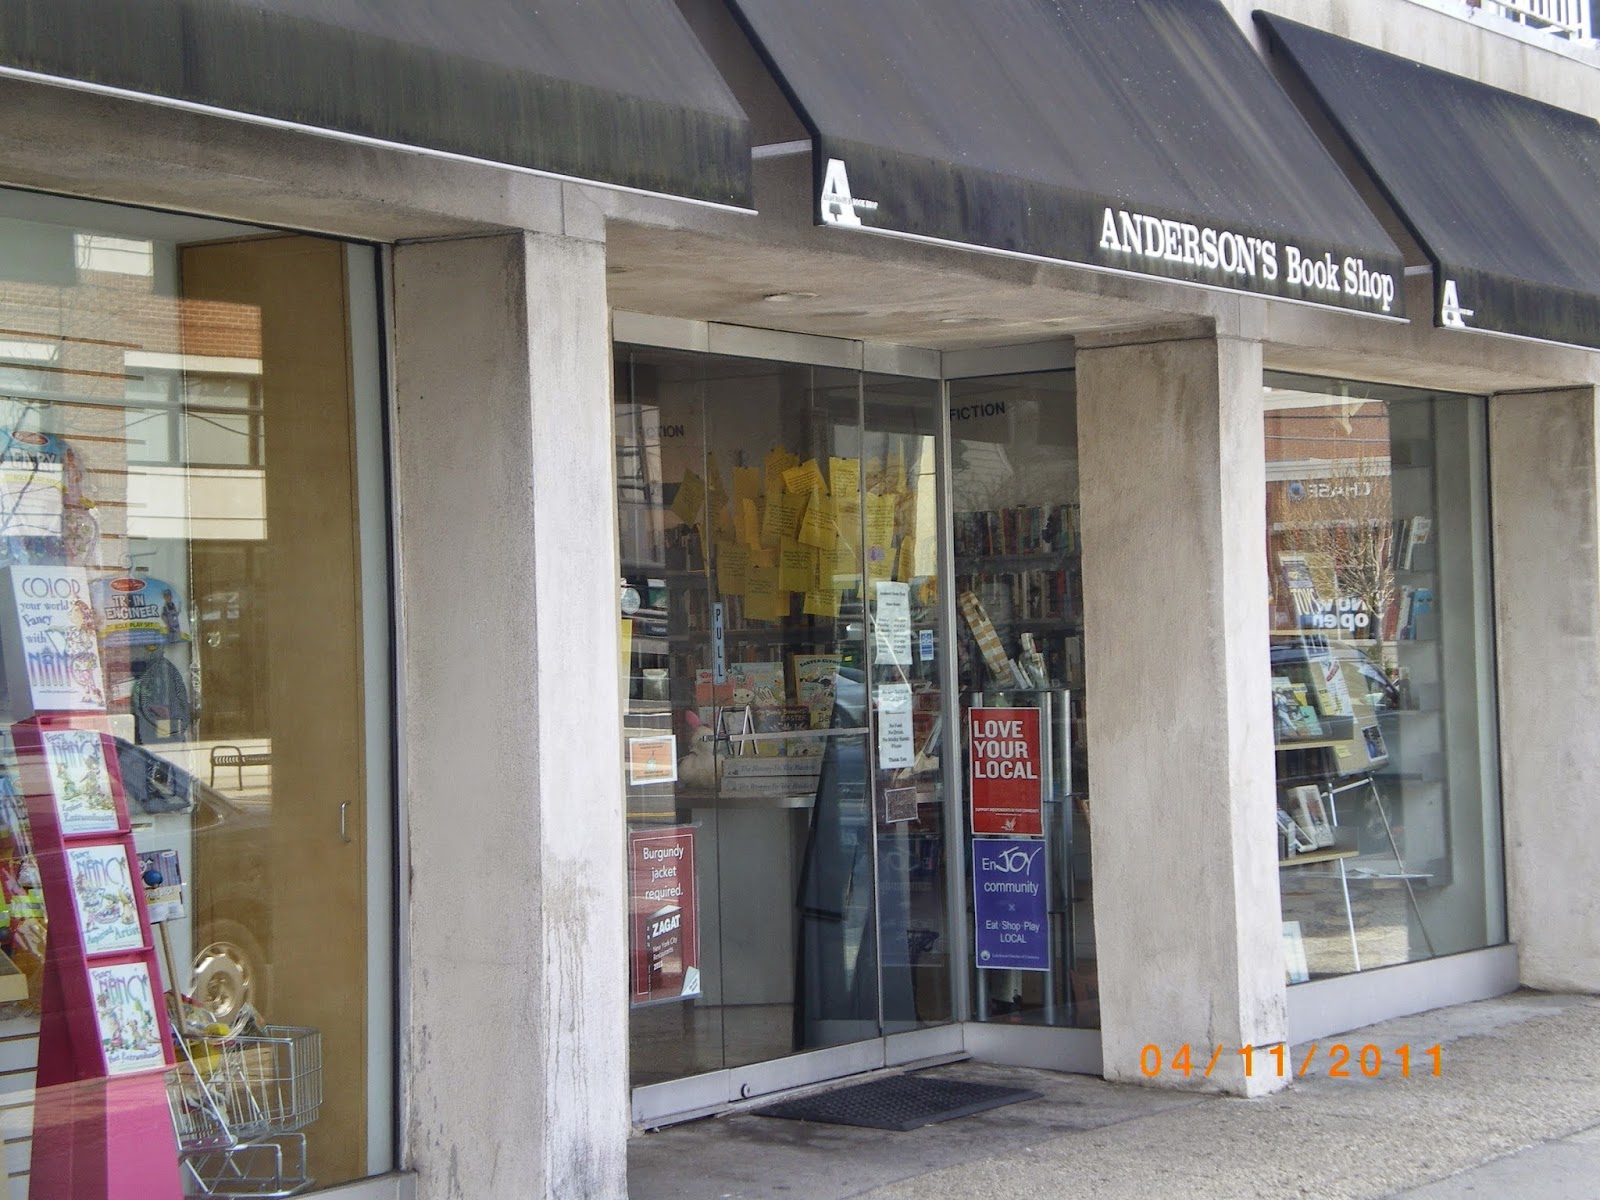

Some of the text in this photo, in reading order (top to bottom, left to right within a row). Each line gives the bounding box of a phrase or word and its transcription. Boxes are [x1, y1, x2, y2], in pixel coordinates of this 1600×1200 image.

[821, 158, 862, 226] A
[1100, 207, 1395, 311] ANDERSON'S Book Shop
[1441, 279, 1467, 328] A
[950, 401, 1005, 421] FICTION
[20, 600, 69, 612] your world
[104, 604, 159, 620] ENGINEER
[22, 614, 52, 627] Fancy
[25, 632, 47, 644] with
[715, 608, 723, 677] PULL
[973, 720, 1024, 738] LOVE
[973, 740, 1029, 758] YOUR
[974, 761, 1038, 779] LOCAL
[643, 844, 684, 861] Burgundy
[982, 846, 1042, 876] EnJOY
[651, 865, 677, 882] jacket
[645, 883, 683, 901] required.
[984, 880, 1039, 896] community
[652, 914, 681, 938] ZAGAT
[986, 920, 1040, 933] Eat Shop Play
[1000, 934, 1027, 944] LOCAL
